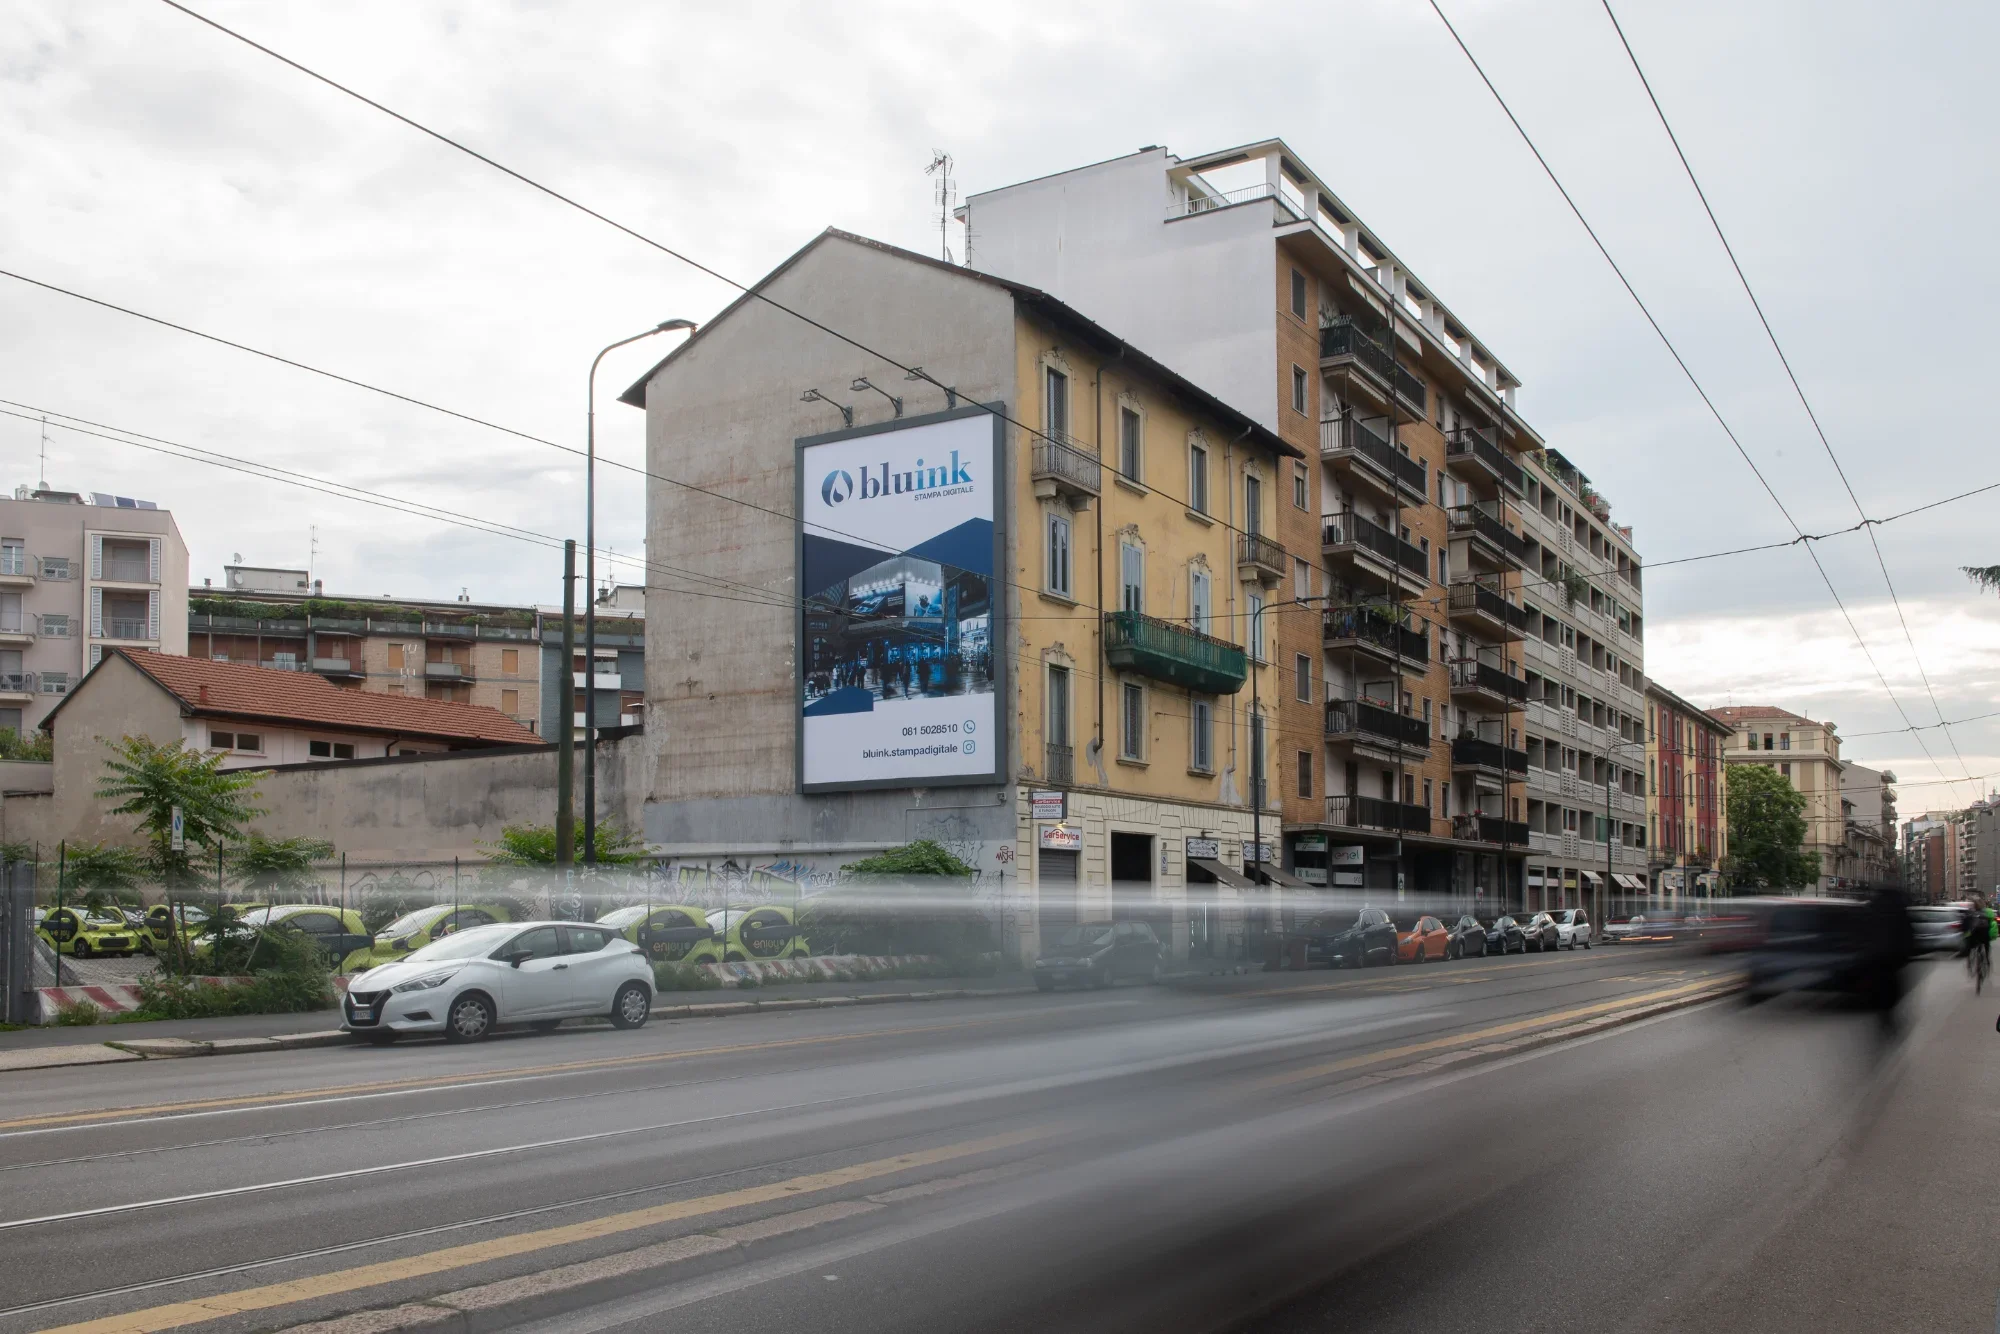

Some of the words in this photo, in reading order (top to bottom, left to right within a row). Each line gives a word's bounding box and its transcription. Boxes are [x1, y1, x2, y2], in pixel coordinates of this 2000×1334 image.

[859, 450, 973, 500] bluink
[914, 491, 942, 501] STAMPA
[943, 486, 973, 496] DIGITALE
[902, 727, 917, 736] 081
[920, 724, 957, 734] 5028510
[862, 743, 958, 759] bluink.stampadigitale
[1044, 831, 1079, 840] CarService
[1335, 850, 1359, 860] enel
[652, 941, 685, 957] enjoy
[752, 939, 780, 953] enjoy
